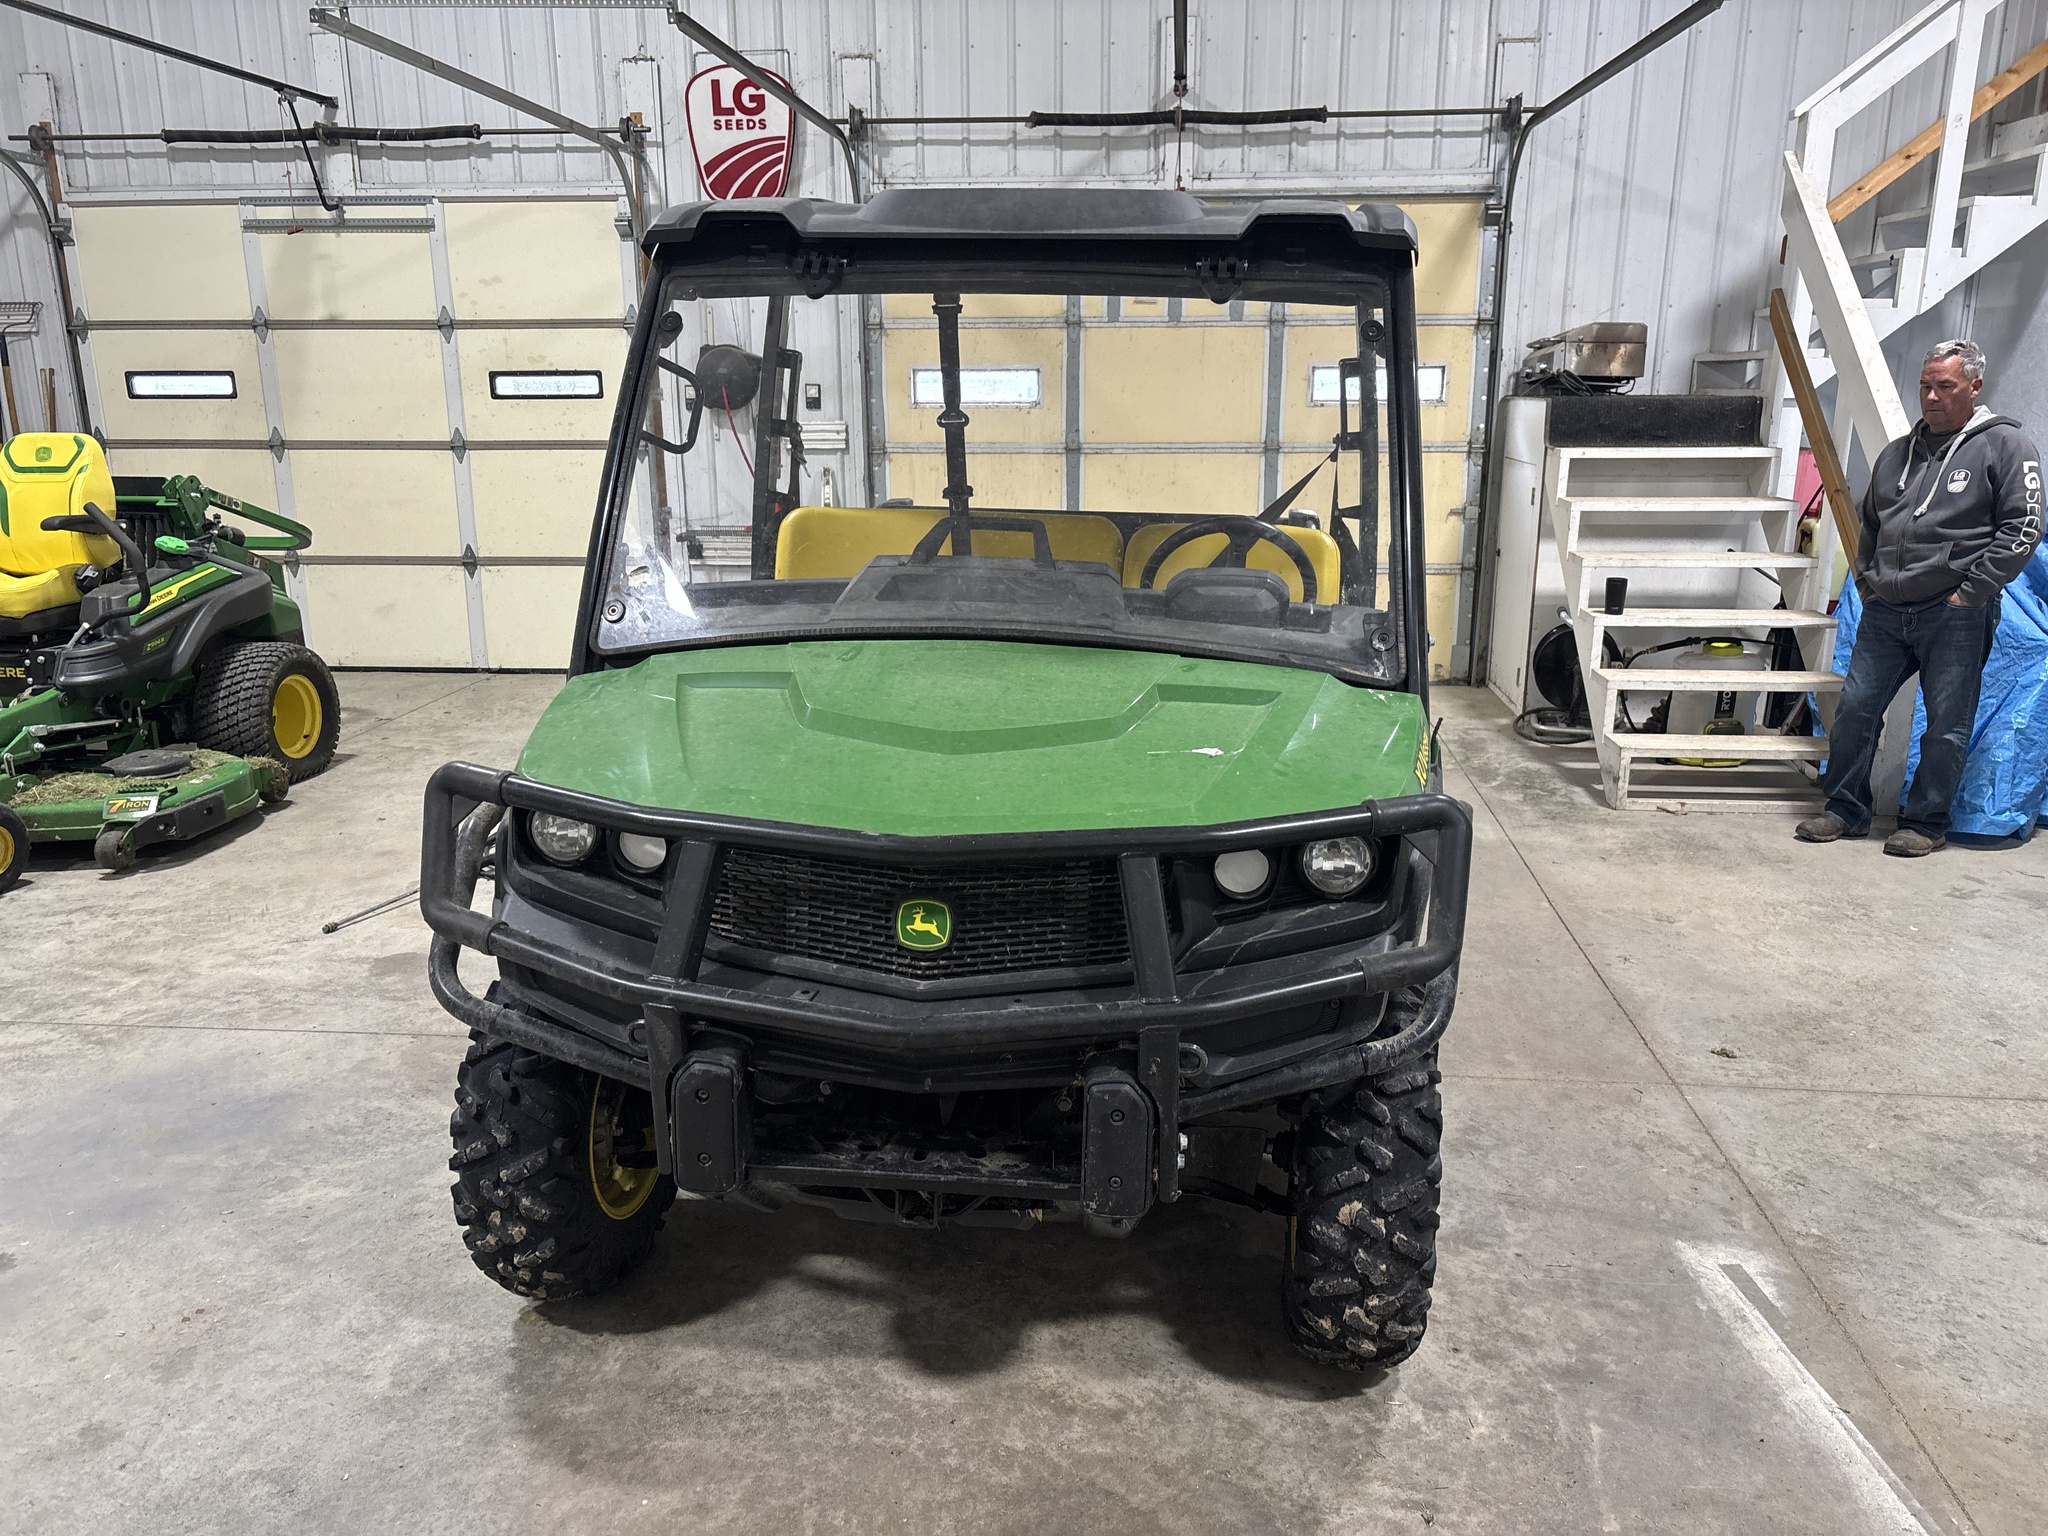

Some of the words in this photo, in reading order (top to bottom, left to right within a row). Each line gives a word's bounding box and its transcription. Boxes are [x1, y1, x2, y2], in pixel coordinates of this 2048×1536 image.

[711, 78, 766, 116] LG
[713, 118, 767, 130] SEEDS
[156, 590, 174, 601] DEERE
[1721, 691, 1732, 711] RYO
[122, 801, 150, 809] IRON
